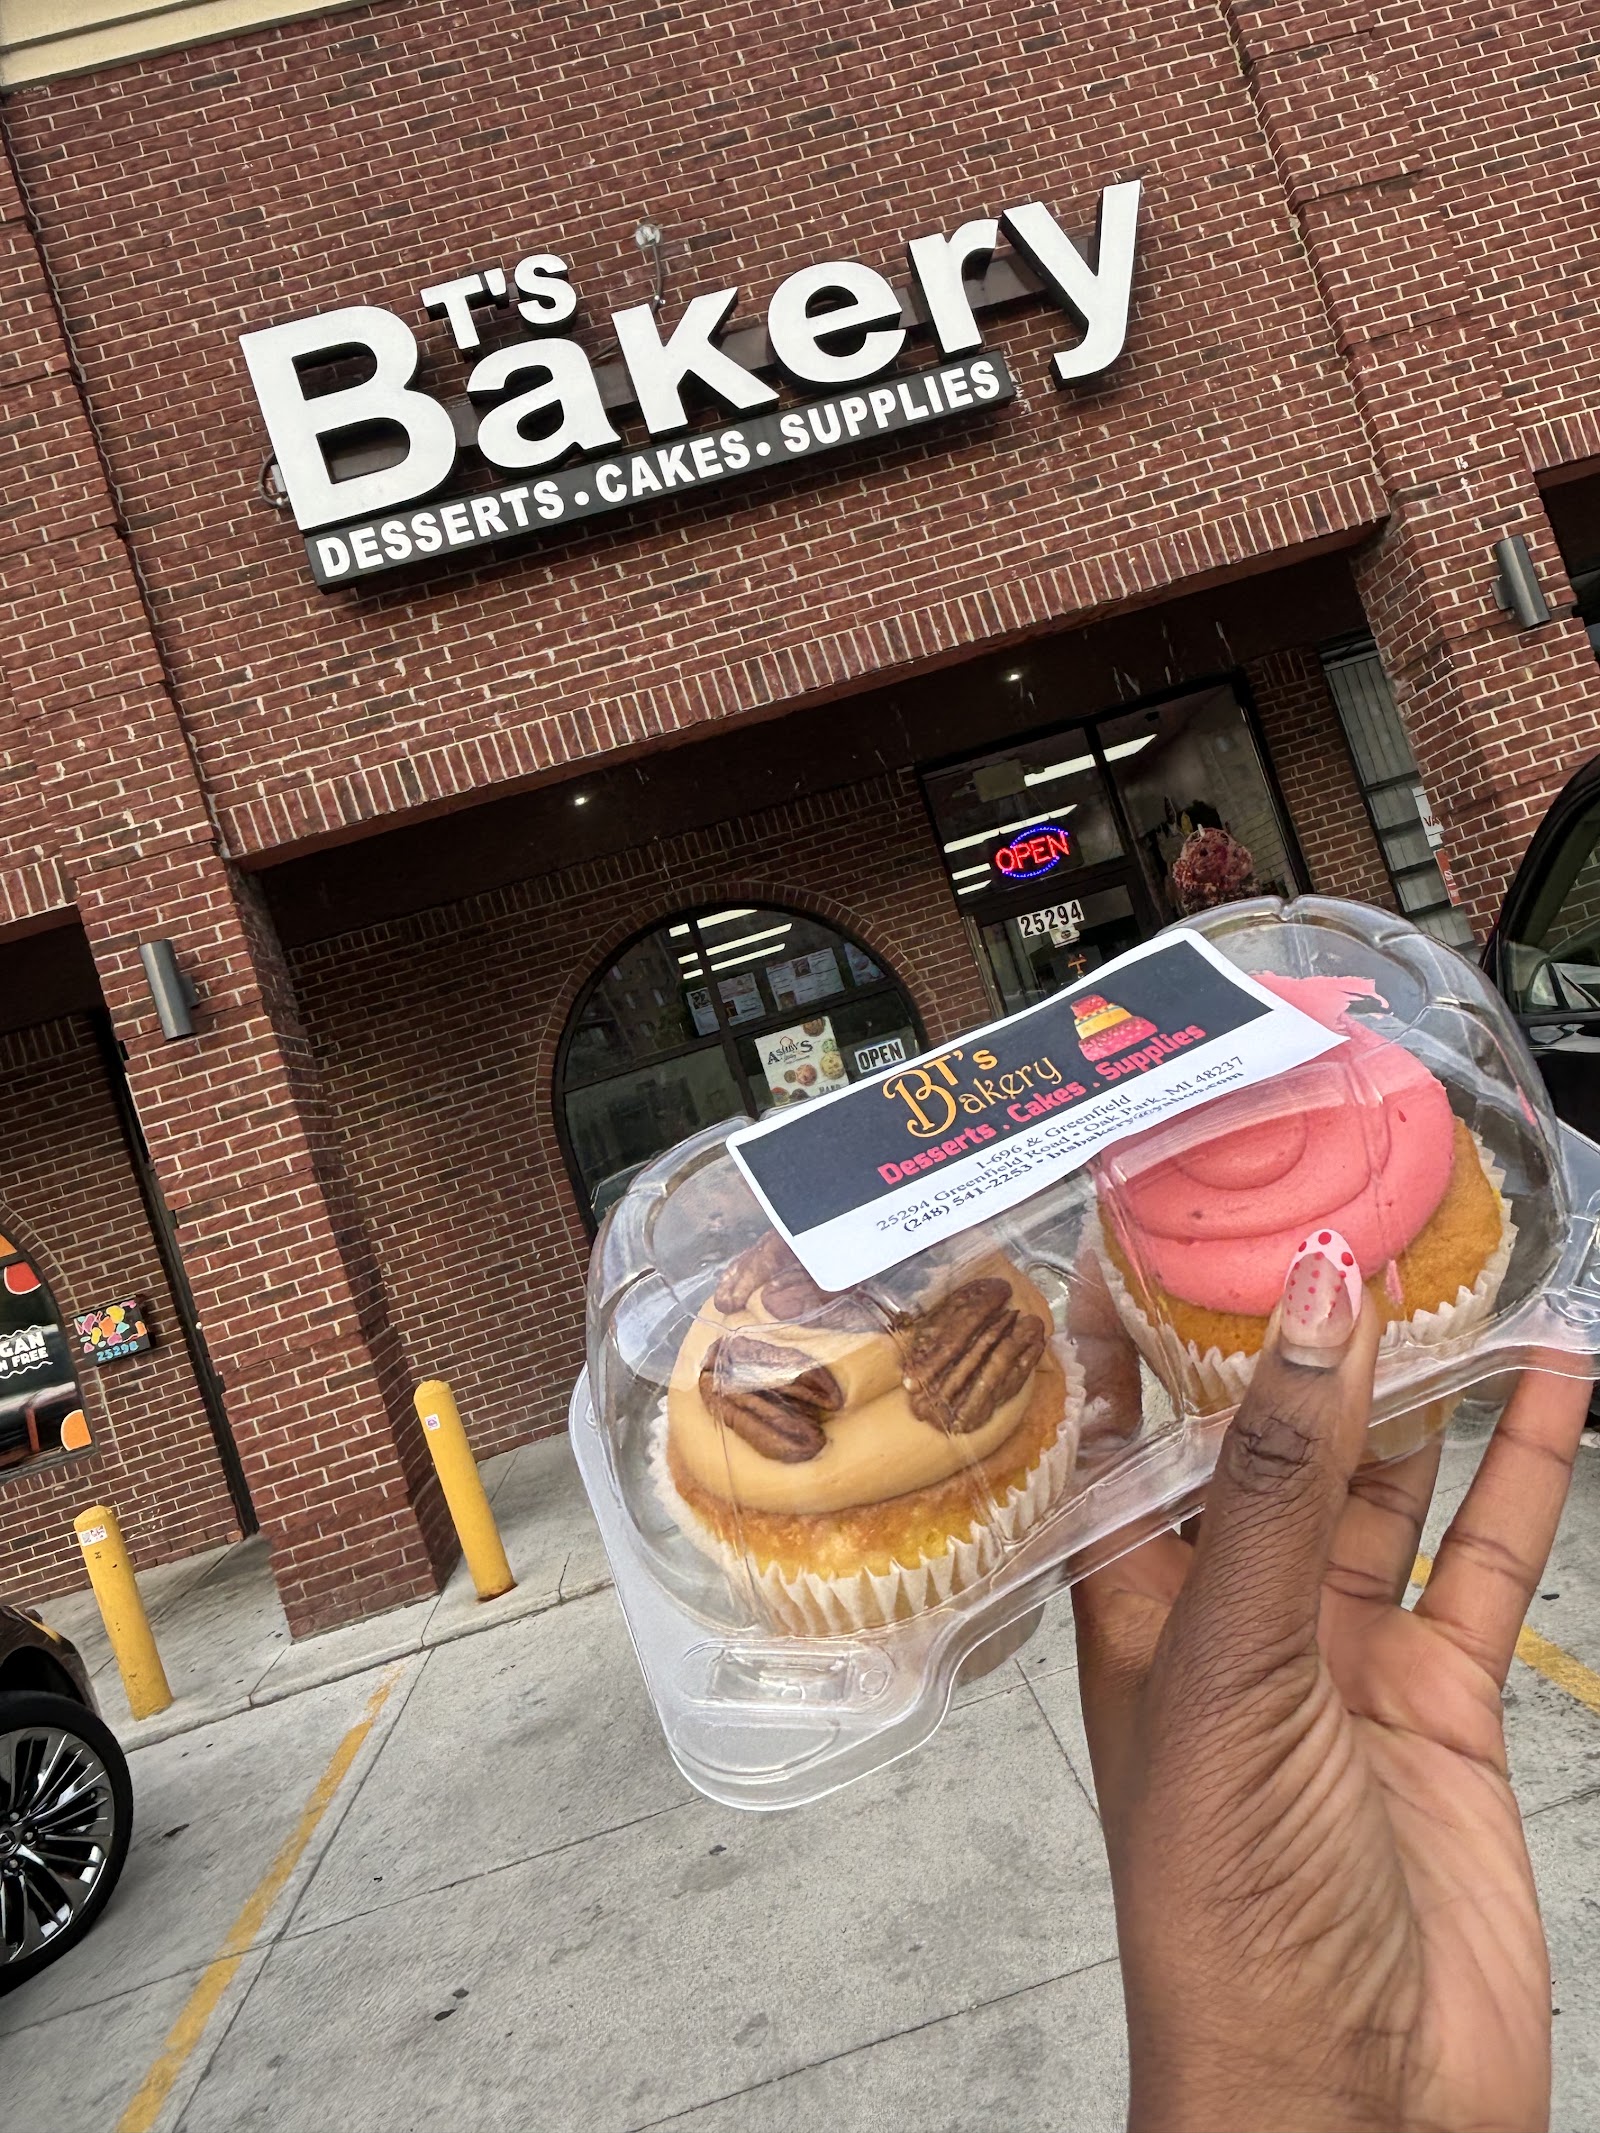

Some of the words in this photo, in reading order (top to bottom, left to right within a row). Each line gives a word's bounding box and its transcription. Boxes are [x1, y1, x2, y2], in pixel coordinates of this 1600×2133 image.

[239, 180, 1142, 531] Bakery
[316, 479, 566, 577] DESSERTS
[595, 431, 752, 504] CAKES
[782, 360, 1001, 453] SUPPLIES
[995, 831, 1070, 873] OPEN
[1021, 902, 1081, 937] 25294
[858, 1041, 903, 1071] OPEN
[877, 1123, 998, 1185] Desserts
[1007, 1081, 1087, 1123] Cakes
[1095, 1023, 1207, 1081] Supplies
[1027, 1137, 1042, 1148] &
[1045, 1094, 1131, 1137] Greenfield
[876, 1200, 930, 1231] 25294
[934, 1157, 1023, 1201] Greenfield
[1024, 1135, 1070, 1159] Road
[1084, 1114, 1120, 1132] Oak
[1165, 1081, 1194, 1096] MI
[1196, 1056, 1243, 1083] 48237
[903, 1205, 951, 1232] (248)
[953, 1164, 1033, 1207] 541-2253
[11, 1346, 49, 1367] FREE
